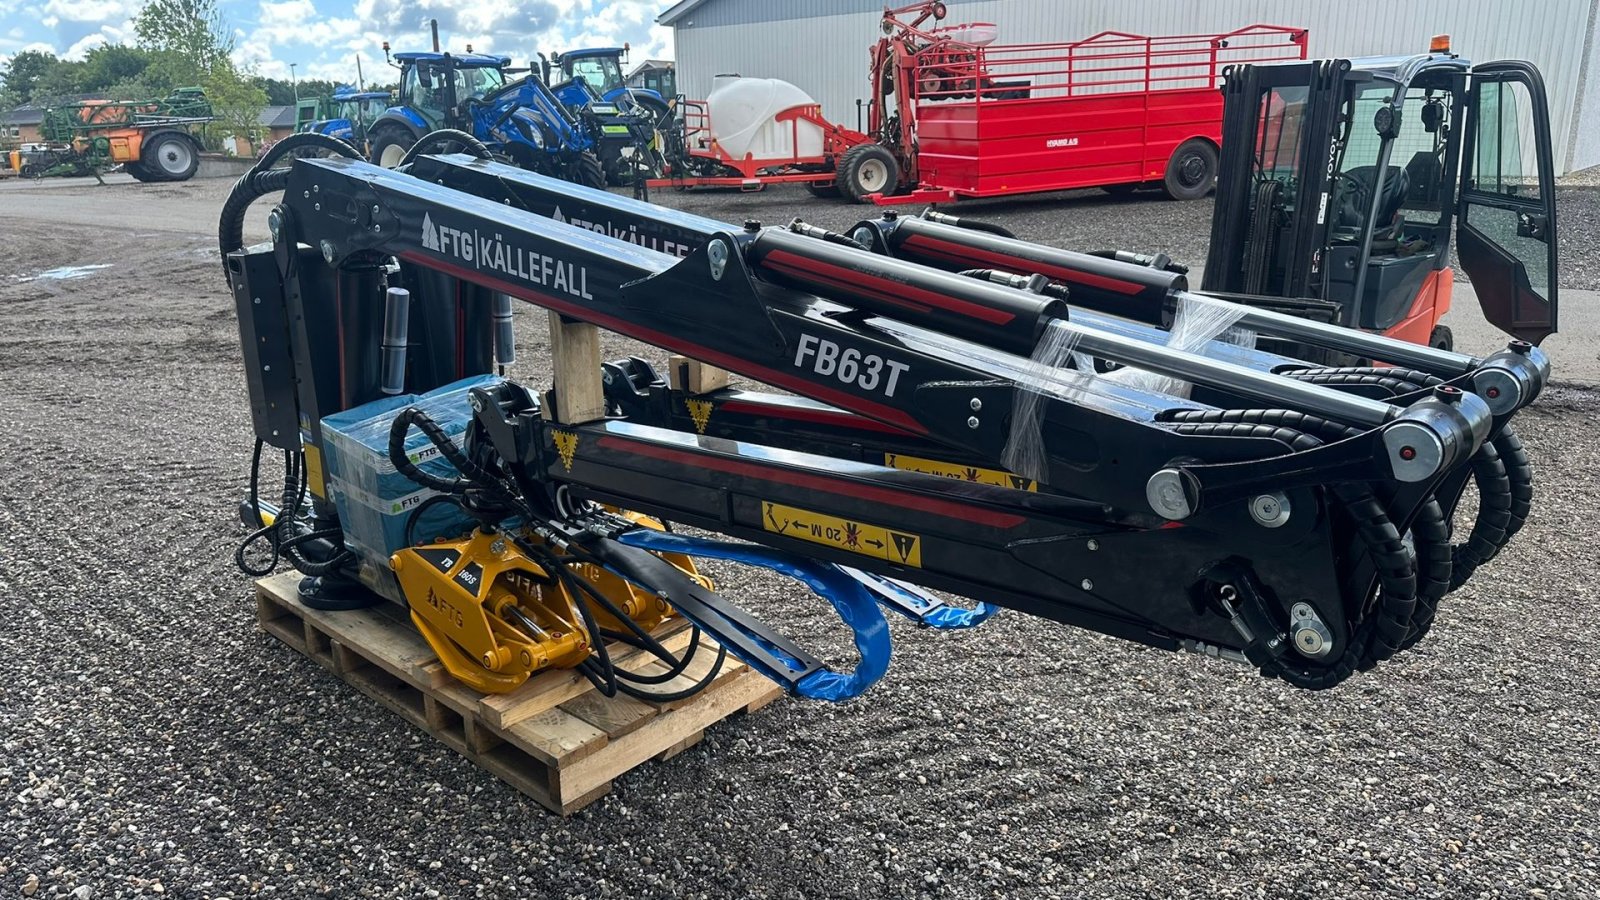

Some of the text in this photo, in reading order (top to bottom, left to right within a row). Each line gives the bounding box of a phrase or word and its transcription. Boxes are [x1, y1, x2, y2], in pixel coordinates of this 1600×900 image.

[1326, 136, 1337, 182] TOYOT
[439, 225, 473, 261] FTG
[481, 233, 593, 300] KÄLLEFALL
[794, 333, 910, 398] FB63T
[418, 447, 437, 459] FTG
[401, 495, 420, 508] FTG
[811, 523, 841, 541] 20 M
[458, 569, 477, 585] 160S
[440, 598, 465, 629] FTG
